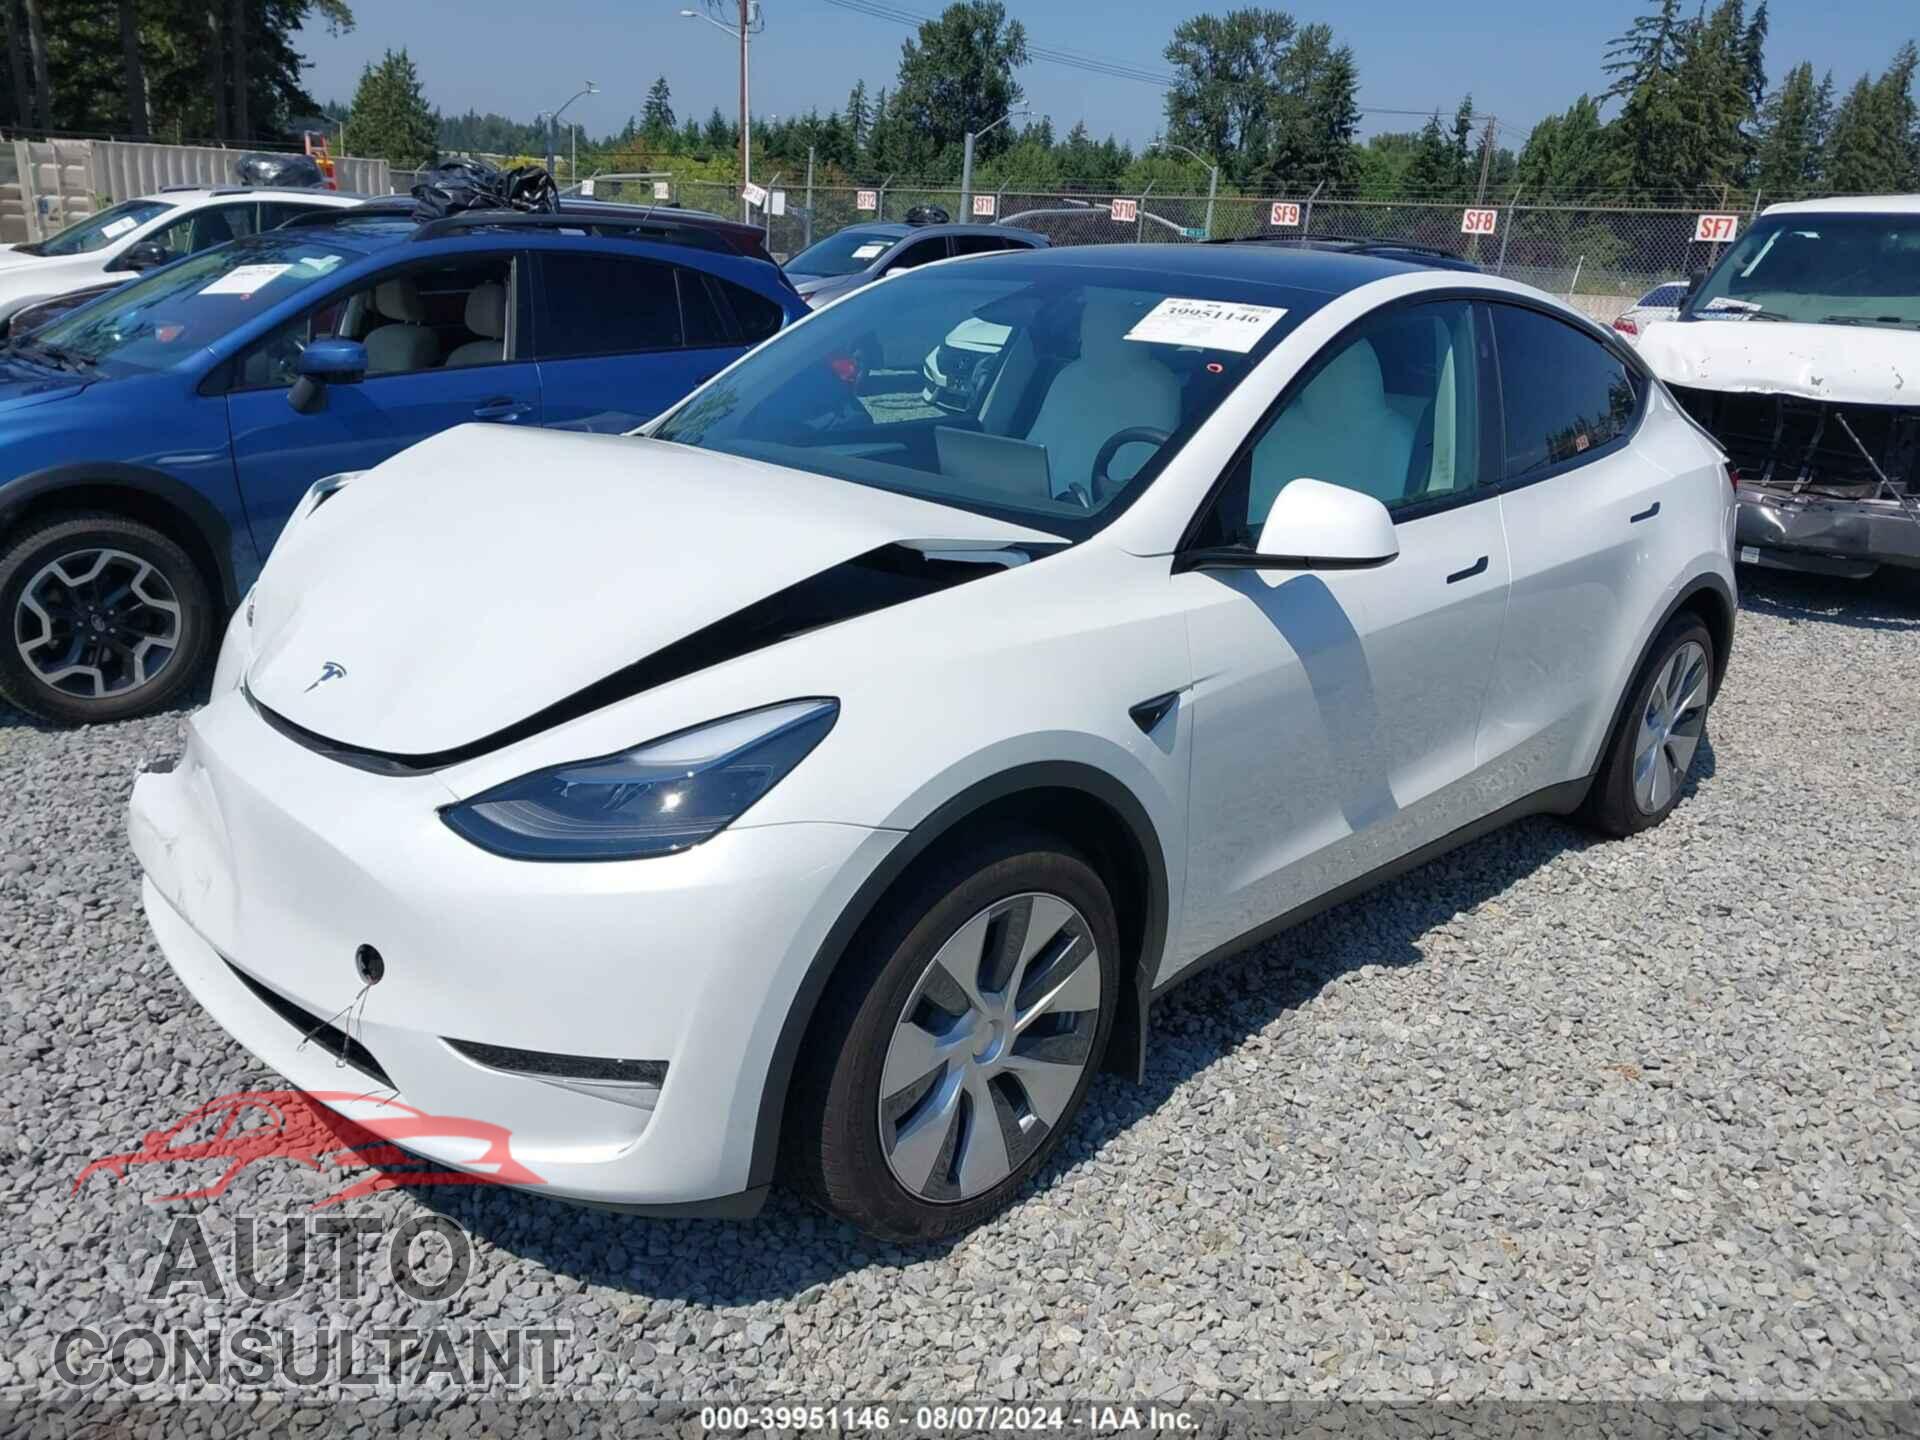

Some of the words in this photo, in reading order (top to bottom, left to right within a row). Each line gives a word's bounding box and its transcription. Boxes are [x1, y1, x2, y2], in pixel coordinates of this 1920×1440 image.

[975, 197, 993, 213] SF11
[1113, 201, 1136, 219] SF10
[1273, 204, 1298, 223] SF9
[1465, 211, 1494, 231] SF8
[1700, 217, 1734, 239] SF7
